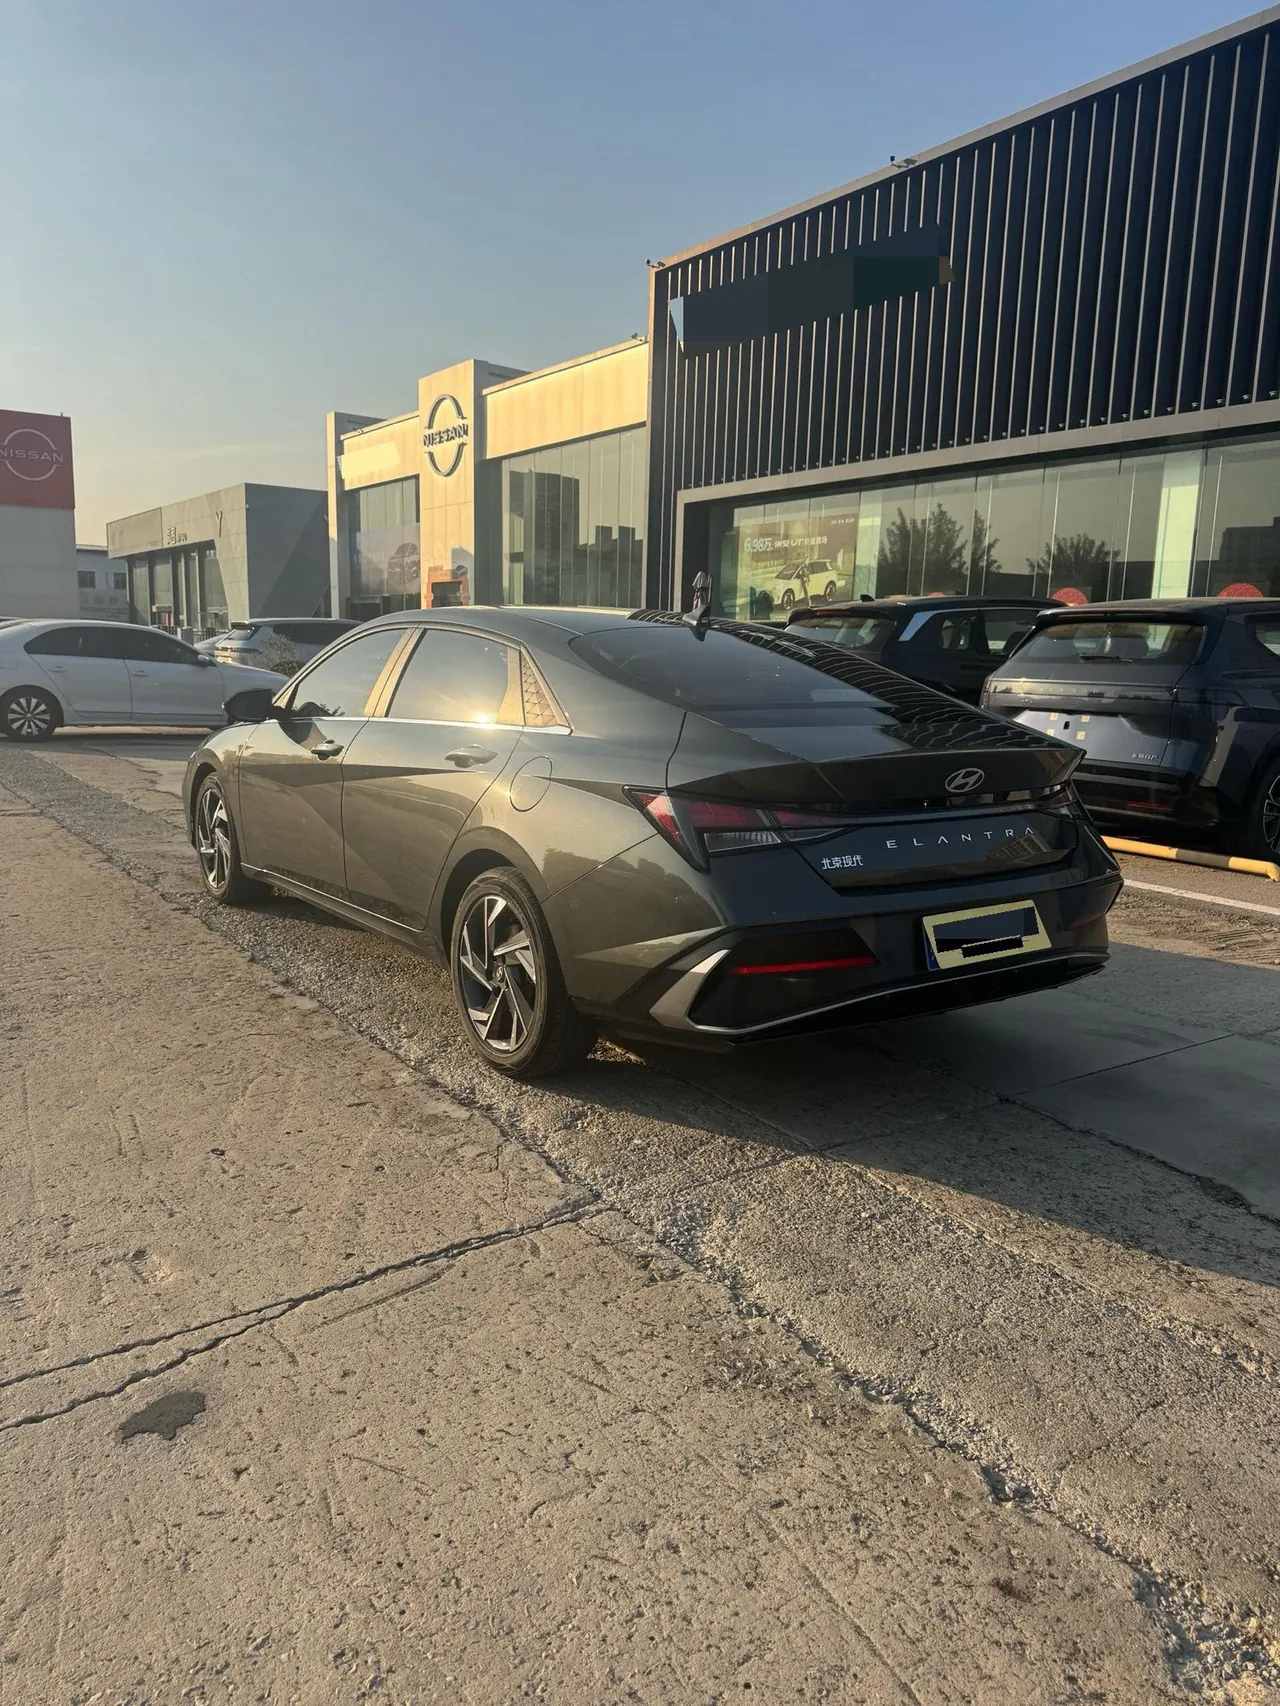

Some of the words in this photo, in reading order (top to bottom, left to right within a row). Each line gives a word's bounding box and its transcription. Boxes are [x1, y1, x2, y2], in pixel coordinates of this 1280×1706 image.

[423, 423, 469, 448] NISSAN
[886, 827, 1034, 849] ELANTRA
[821, 854, 864, 870] 北京现代
